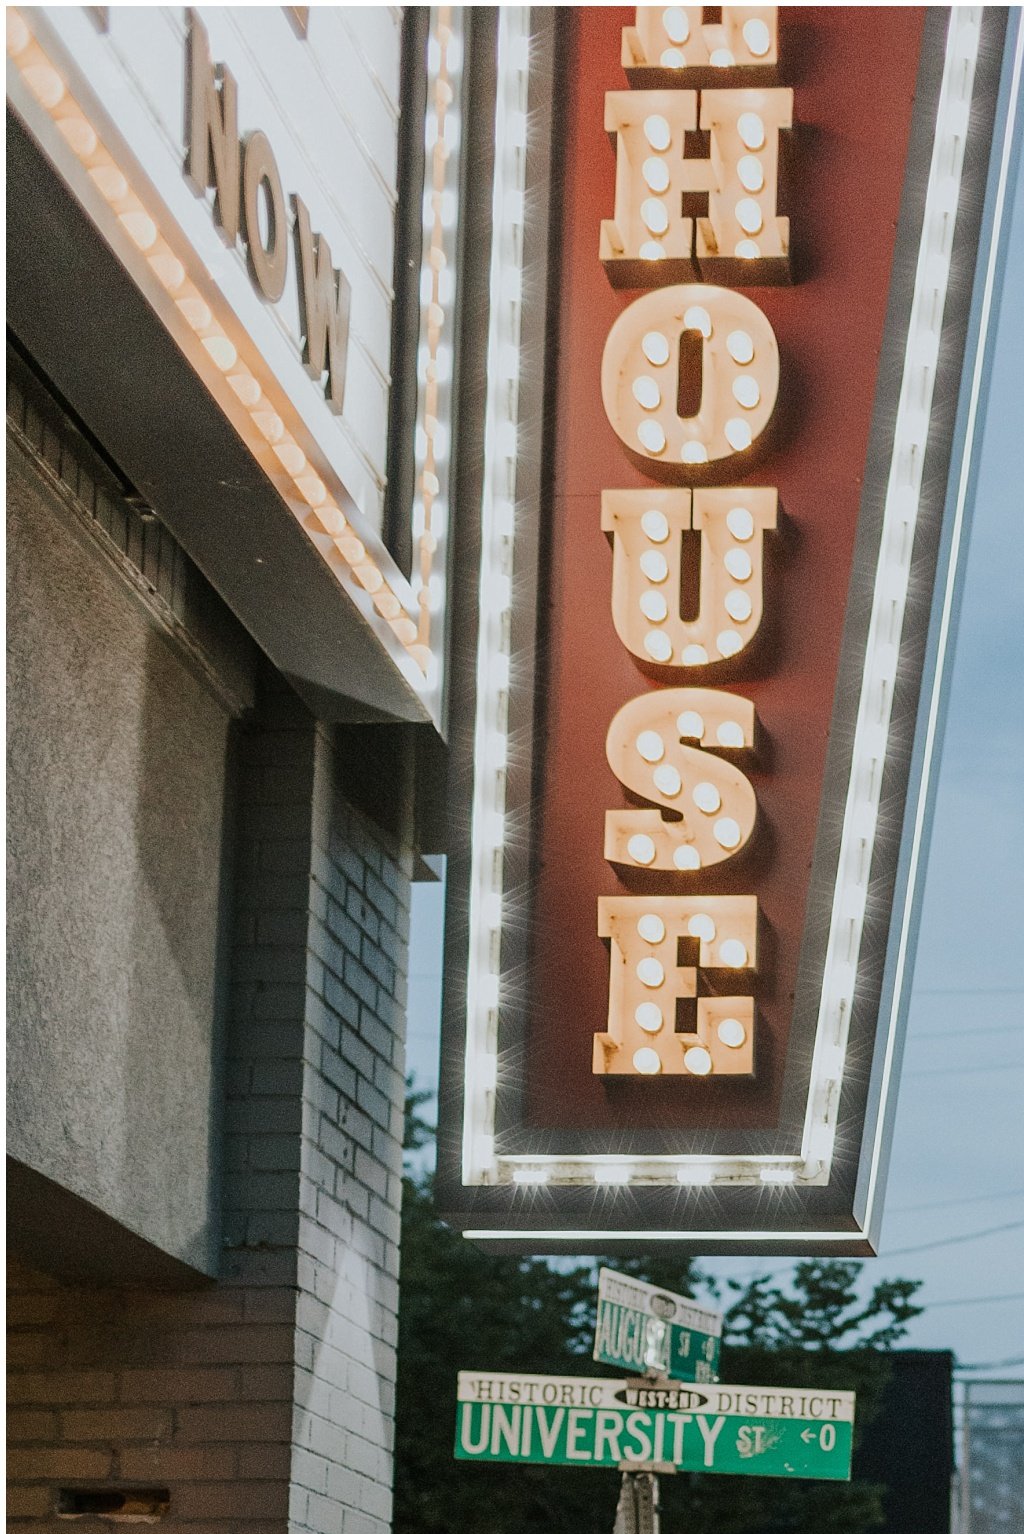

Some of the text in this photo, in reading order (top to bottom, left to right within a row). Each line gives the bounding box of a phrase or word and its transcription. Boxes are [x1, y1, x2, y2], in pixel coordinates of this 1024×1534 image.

[183, 6, 352, 416] NOW
[477, 1379, 603, 1408] HISTORIC
[716, 1392, 842, 1418] DISTRICT
[461, 1403, 726, 1467] UNIVERSITY
[737, 1425, 766, 1456] ST
